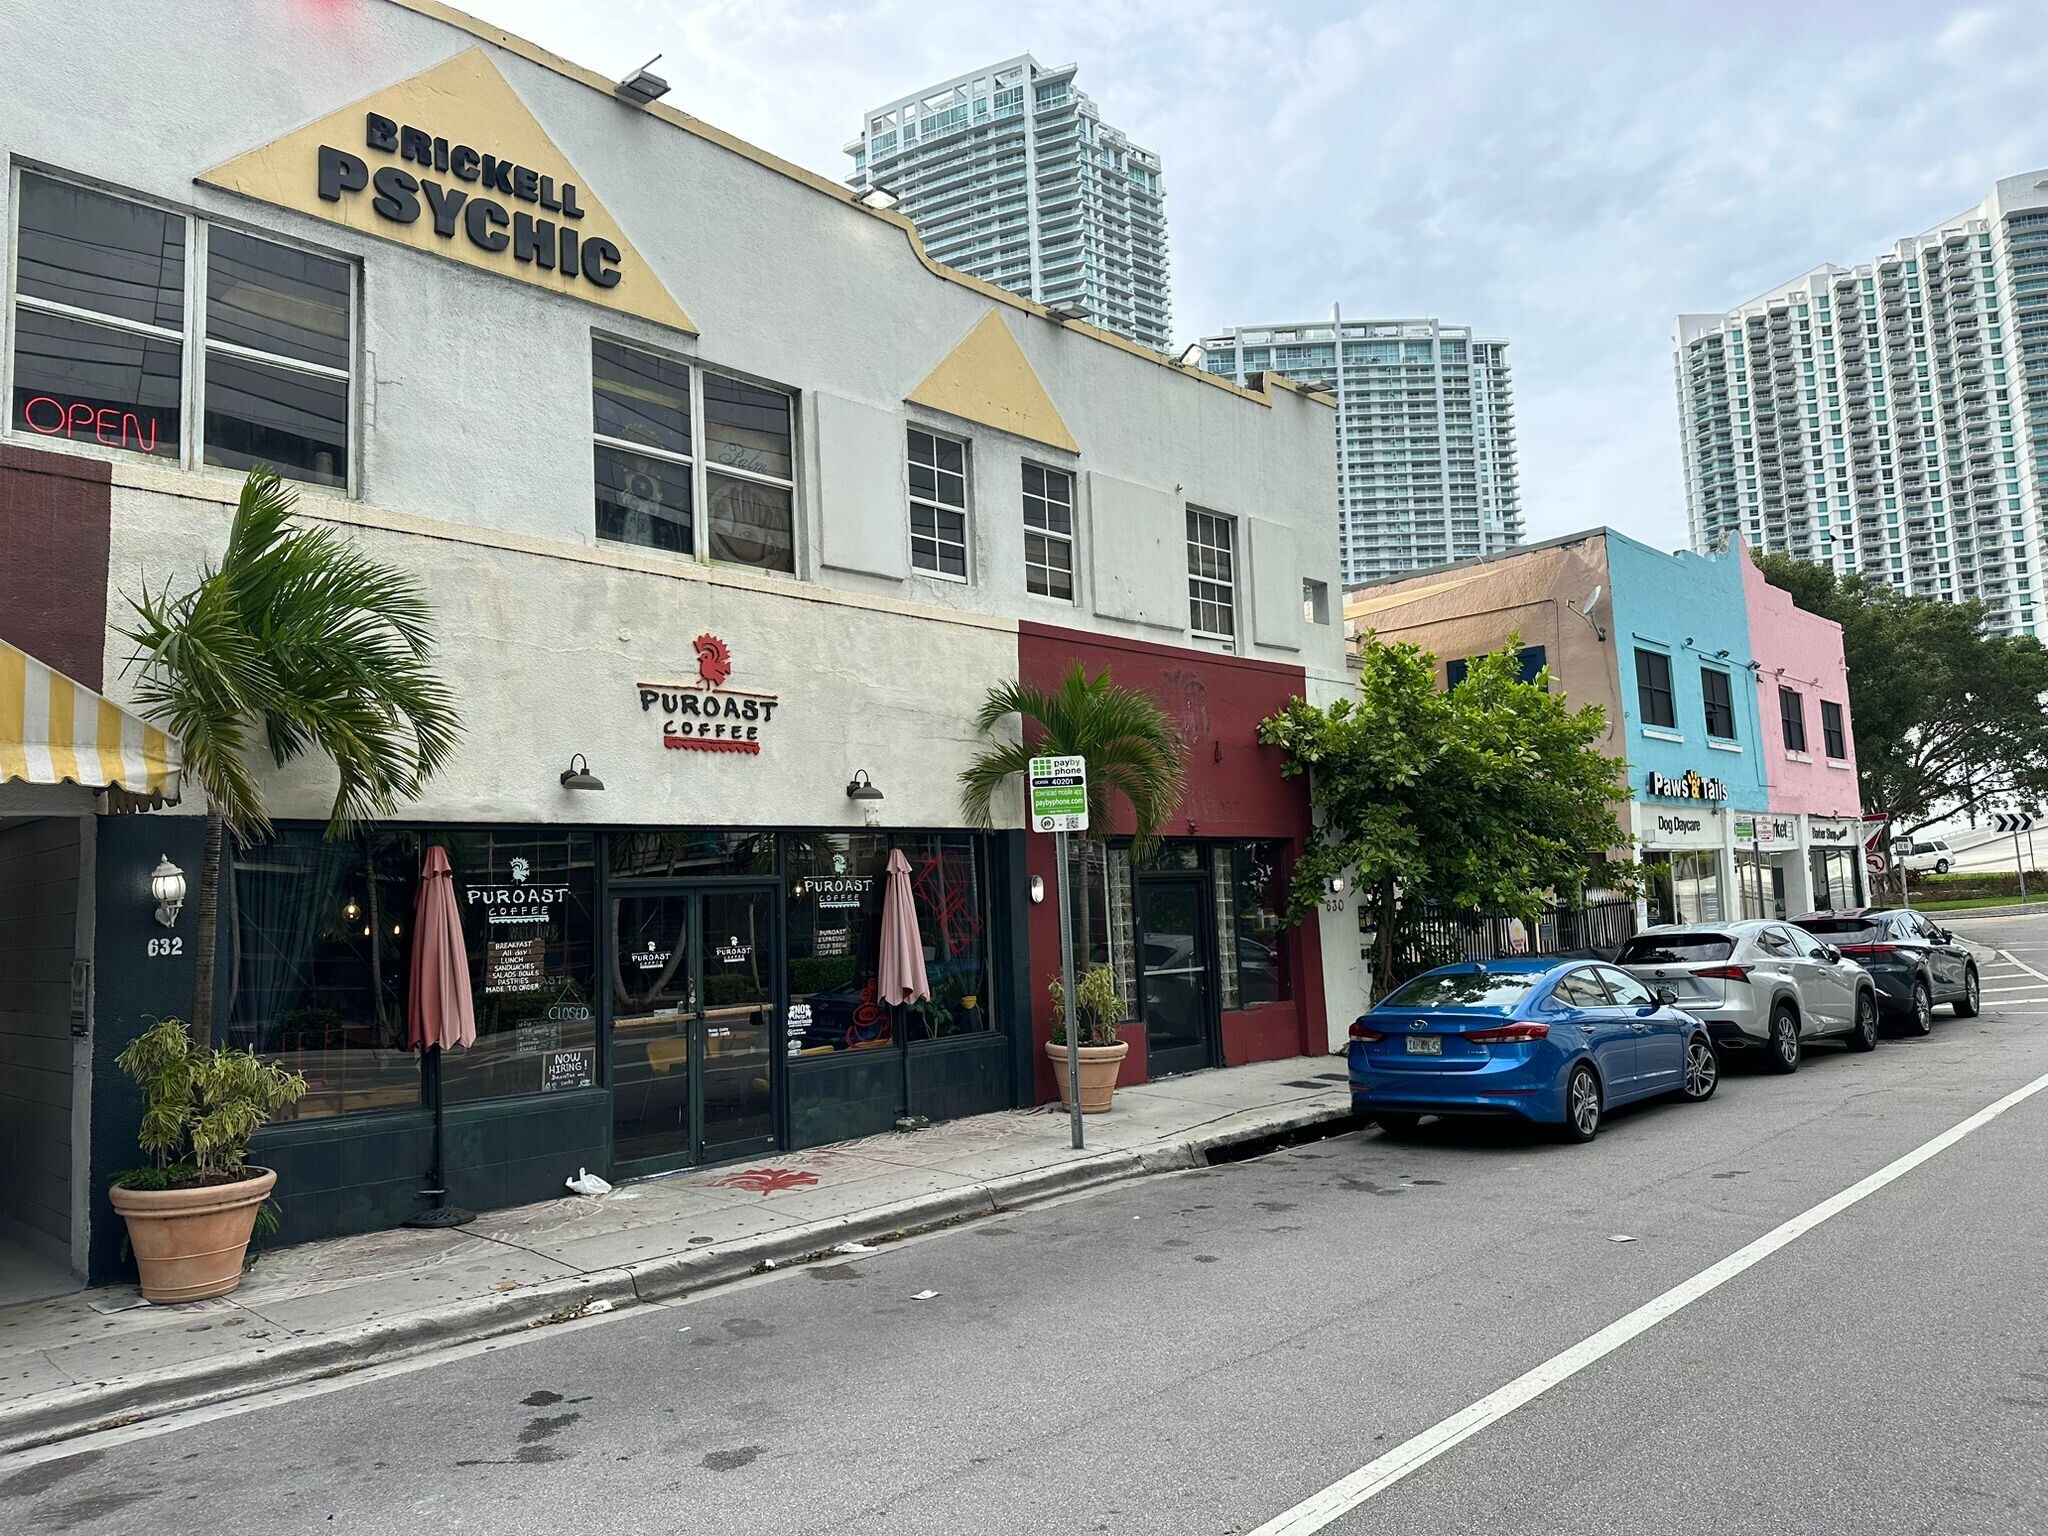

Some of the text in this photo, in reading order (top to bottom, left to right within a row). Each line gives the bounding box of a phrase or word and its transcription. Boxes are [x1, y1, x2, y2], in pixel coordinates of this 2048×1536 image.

[366, 112, 585, 219] BRICKELL
[319, 145, 622, 288] PSYCHIC
[25, 397, 156, 452] OPEN
[718, 443, 768, 473] Palm
[640, 689, 778, 721] PUROAST
[663, 720, 758, 740] COFFEE
[1054, 759, 1080, 767] payby
[1054, 768, 1082, 776] phone
[1651, 771, 1728, 801] Paws & Tails
[1035, 798, 1084, 807] paybyphone.com
[1658, 816, 1700, 835] Dog Daycare
[804, 879, 873, 892] PUROAST
[467, 889, 568, 904] PUROAST
[819, 893, 860, 902] COFFEE
[489, 906, 549, 916] COFFEE
[1326, 899, 1344, 912] 630
[495, 940, 533, 950] BREAKFAST
[818, 935, 846, 943] ESPRESSO
[147, 936, 183, 957] 632
[716, 947, 752, 956] PUROAST
[632, 953, 671, 962] PUROAST
[492, 971, 517, 979] SALADS
[497, 978, 529, 986] PASTRIES
[507, 984, 517, 992] TO
[519, 983, 540, 991] ORDER
[548, 1006, 589, 1020] CLOSED
[555, 1052, 581, 1065] NOW
